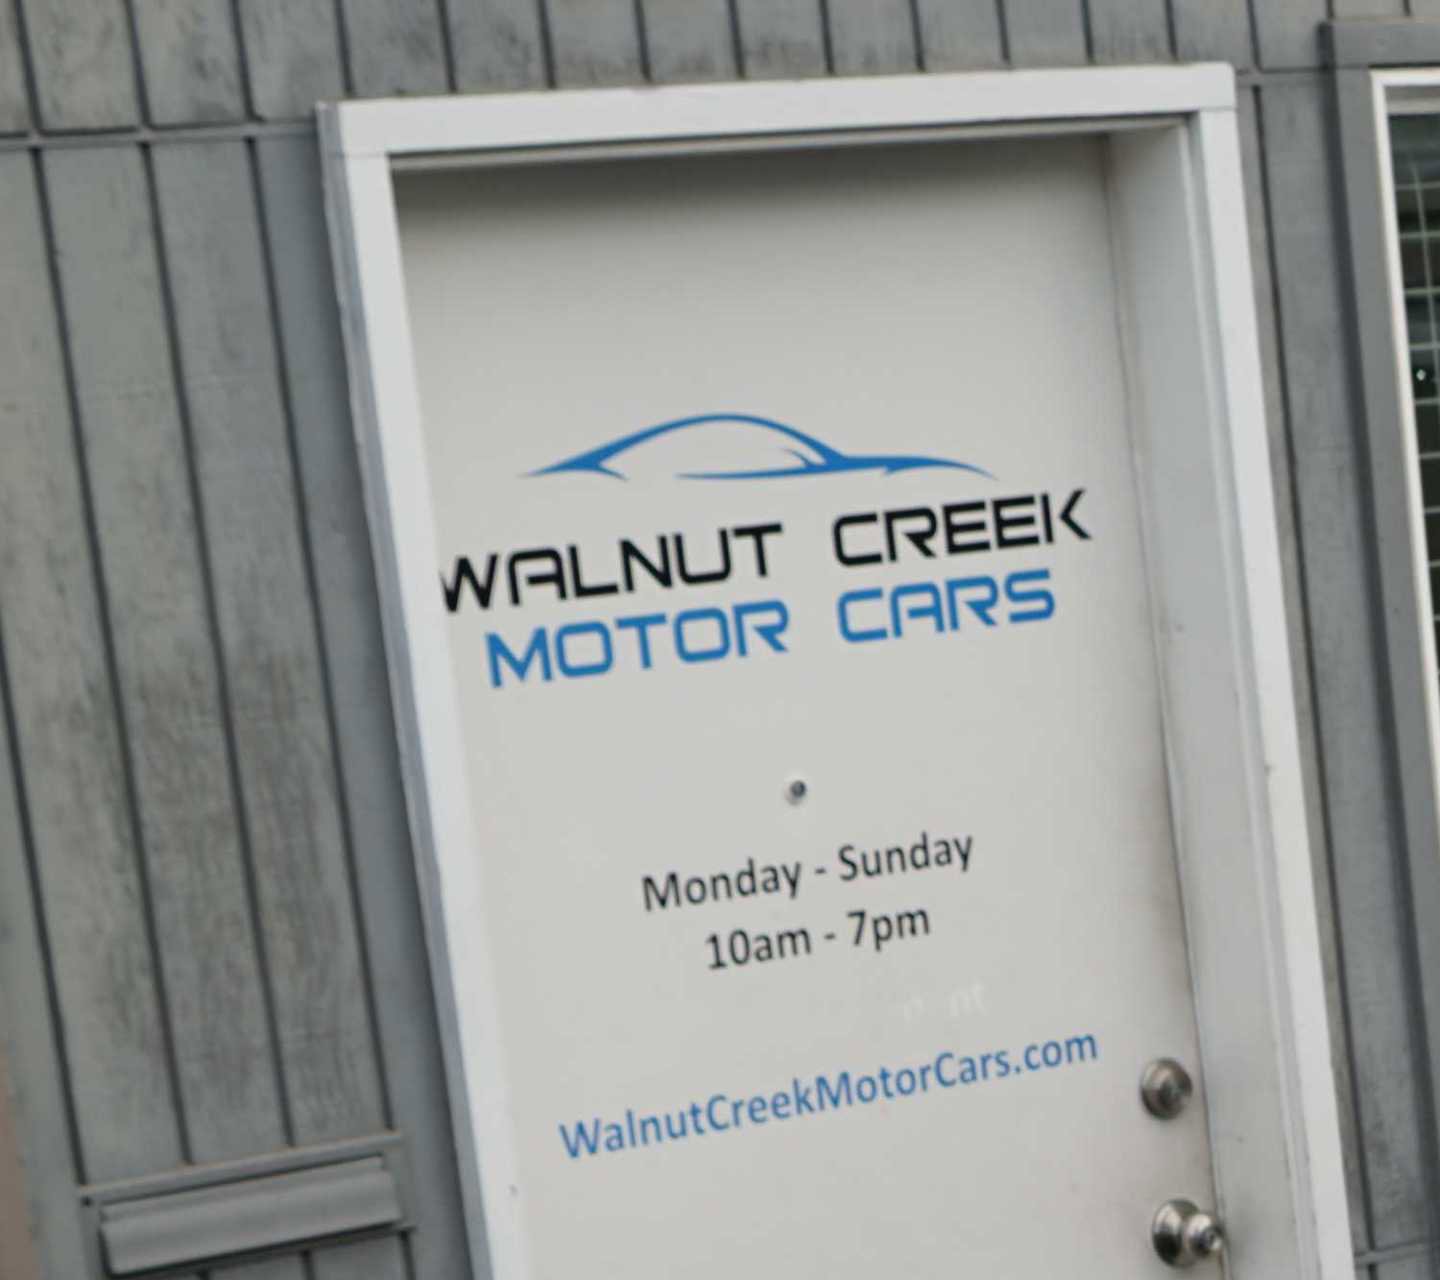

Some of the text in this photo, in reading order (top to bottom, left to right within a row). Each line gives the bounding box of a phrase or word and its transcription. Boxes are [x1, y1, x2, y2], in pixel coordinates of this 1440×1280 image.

[439, 488, 1092, 614] WALNUT CREEK
[484, 567, 1057, 689] MOTOR CARS
[641, 859, 801, 911] Monday
[837, 831, 974, 882] Sunday
[707, 928, 812, 970] 10am
[846, 908, 931, 954] 7pm
[558, 1034, 1099, 1159] WalnutCreekMotorCars.com
